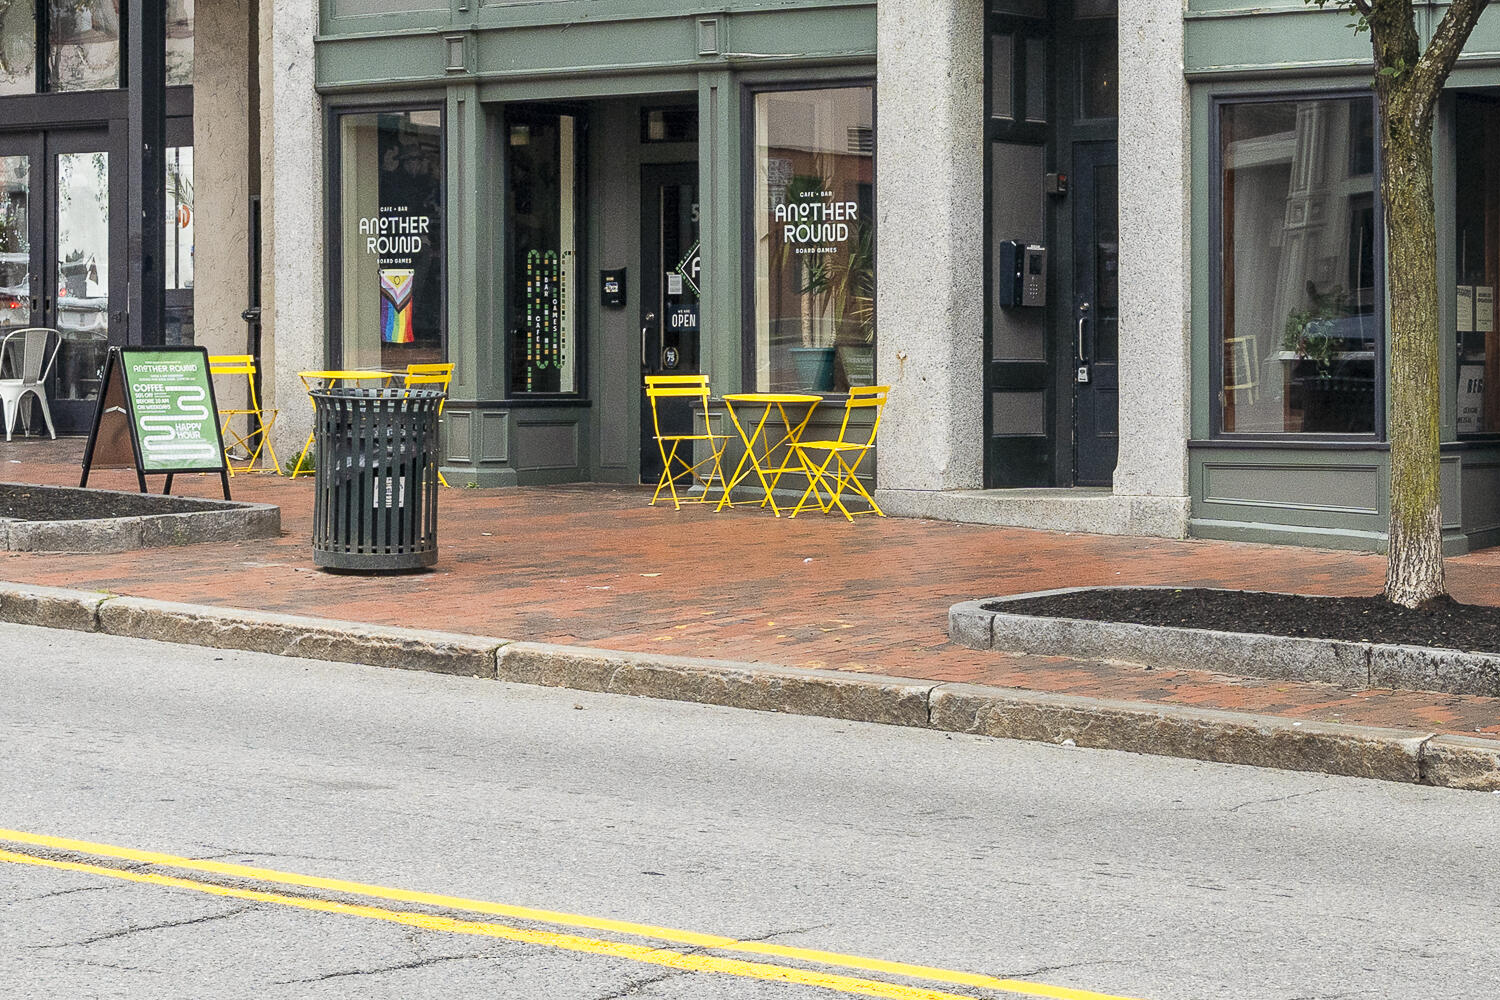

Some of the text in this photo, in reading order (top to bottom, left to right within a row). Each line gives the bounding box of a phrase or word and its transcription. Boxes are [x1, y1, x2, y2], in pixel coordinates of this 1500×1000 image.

[775, 202, 857, 222] ANOTHER
[359, 216, 430, 235] ANOTHER
[784, 223, 849, 243] ROUND
[367, 236, 422, 254] ROUND
[671, 314, 696, 328] OPEN
[170, 364, 198, 372] ROUND
[133, 384, 165, 392] COFFEE
[175, 422, 202, 431] HAPPY
[177, 431, 201, 439] HOUR
